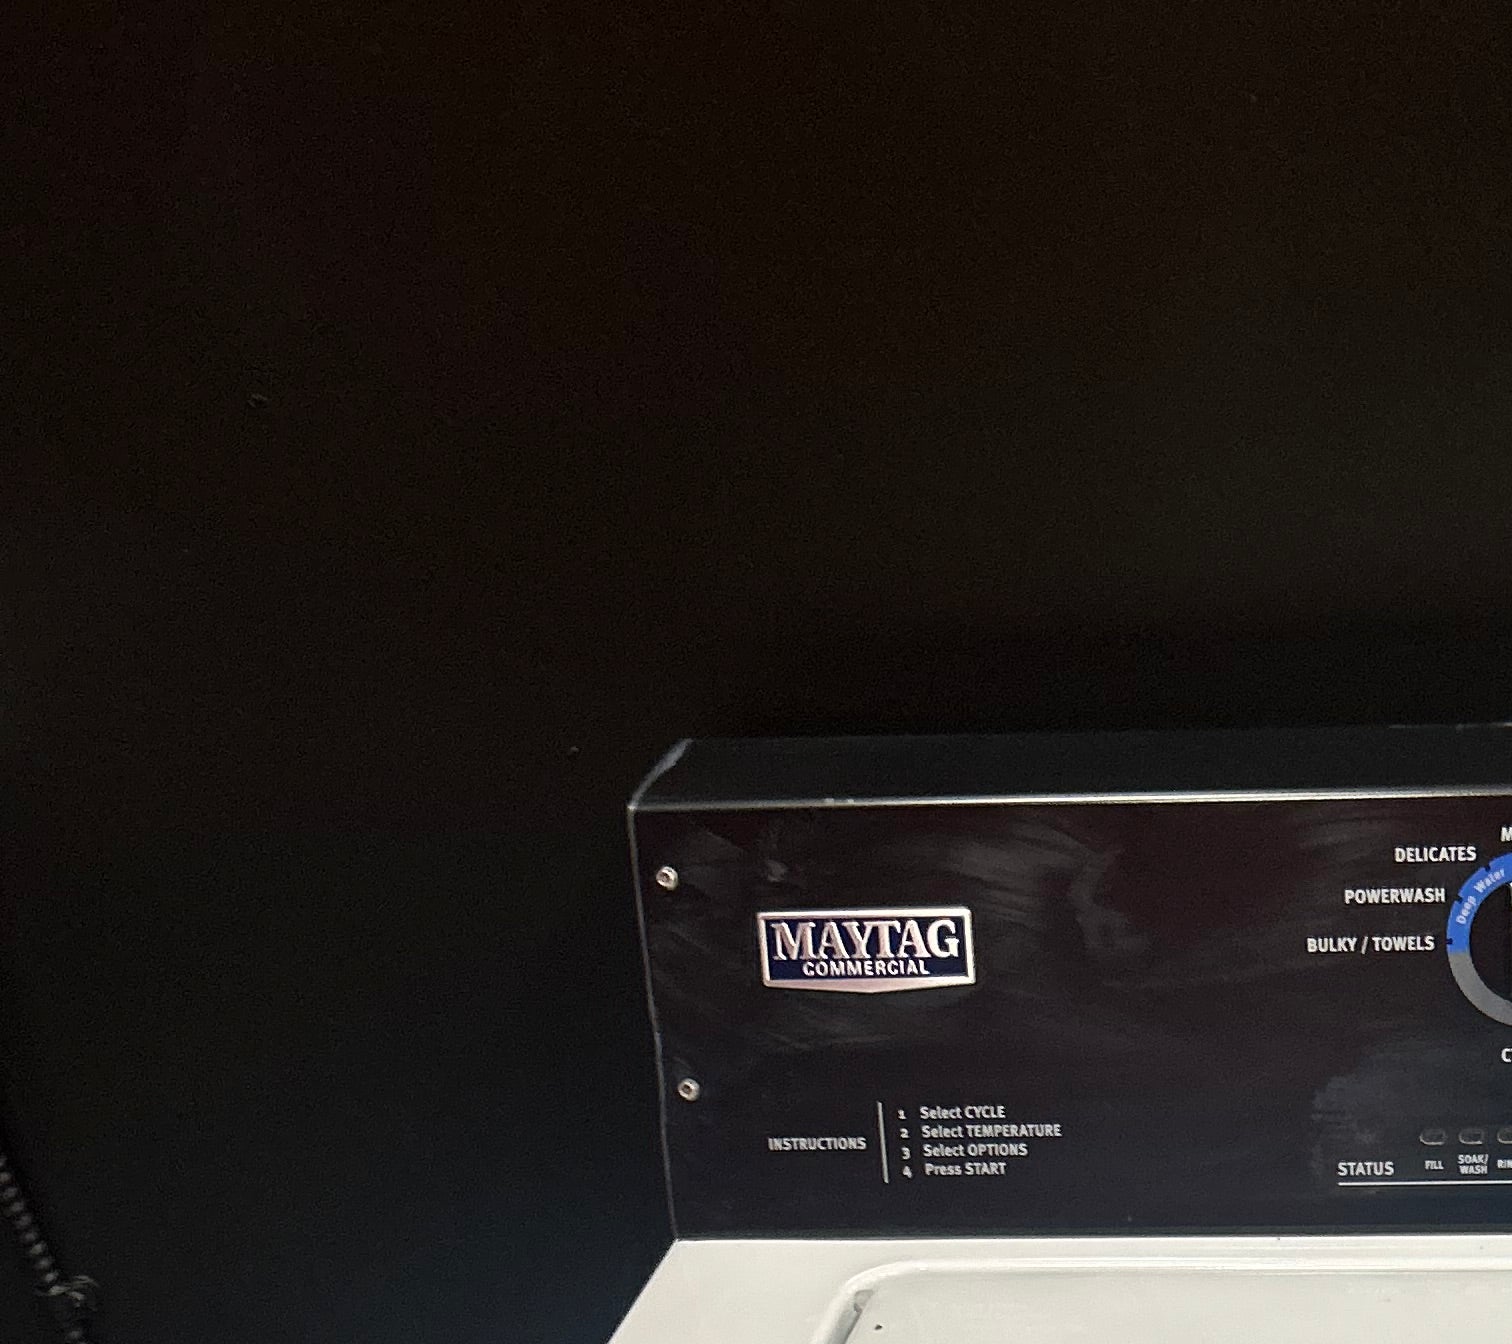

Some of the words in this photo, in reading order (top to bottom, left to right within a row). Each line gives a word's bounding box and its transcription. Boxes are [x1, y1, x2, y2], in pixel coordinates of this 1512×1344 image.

[1394, 845, 1477, 863] DELICATES
[1344, 887, 1446, 904] POWERWASH
[1456, 895, 1477, 925] Deep
[769, 919, 960, 961] MAYTAG
[1306, 936, 1358, 953] BULKY
[1360, 935, 1369, 955] /
[1371, 935, 1435, 952] TOWELS
[802, 959, 931, 977] COMMERCIAL
[919, 1105, 963, 1120] Select
[964, 1105, 1006, 1119] CYCLE
[899, 1127, 910, 1139] 2
[921, 1124, 964, 1139] Select
[965, 1123, 1063, 1138] TEMPERATURE
[768, 1136, 867, 1151] INSTRUCTIONS
[901, 1146, 911, 1160] 3
[922, 1143, 966, 1157] Select
[967, 1142, 1029, 1157] OPTIONS
[1424, 1160, 1445, 1170] FILL
[1457, 1153, 1489, 1165] SOAK/
[902, 1165, 913, 1179] 4
[924, 1162, 963, 1176] Press
[964, 1161, 1007, 1176] START
[1337, 1161, 1395, 1176] STATUS
[1459, 1164, 1488, 1175] WASH
